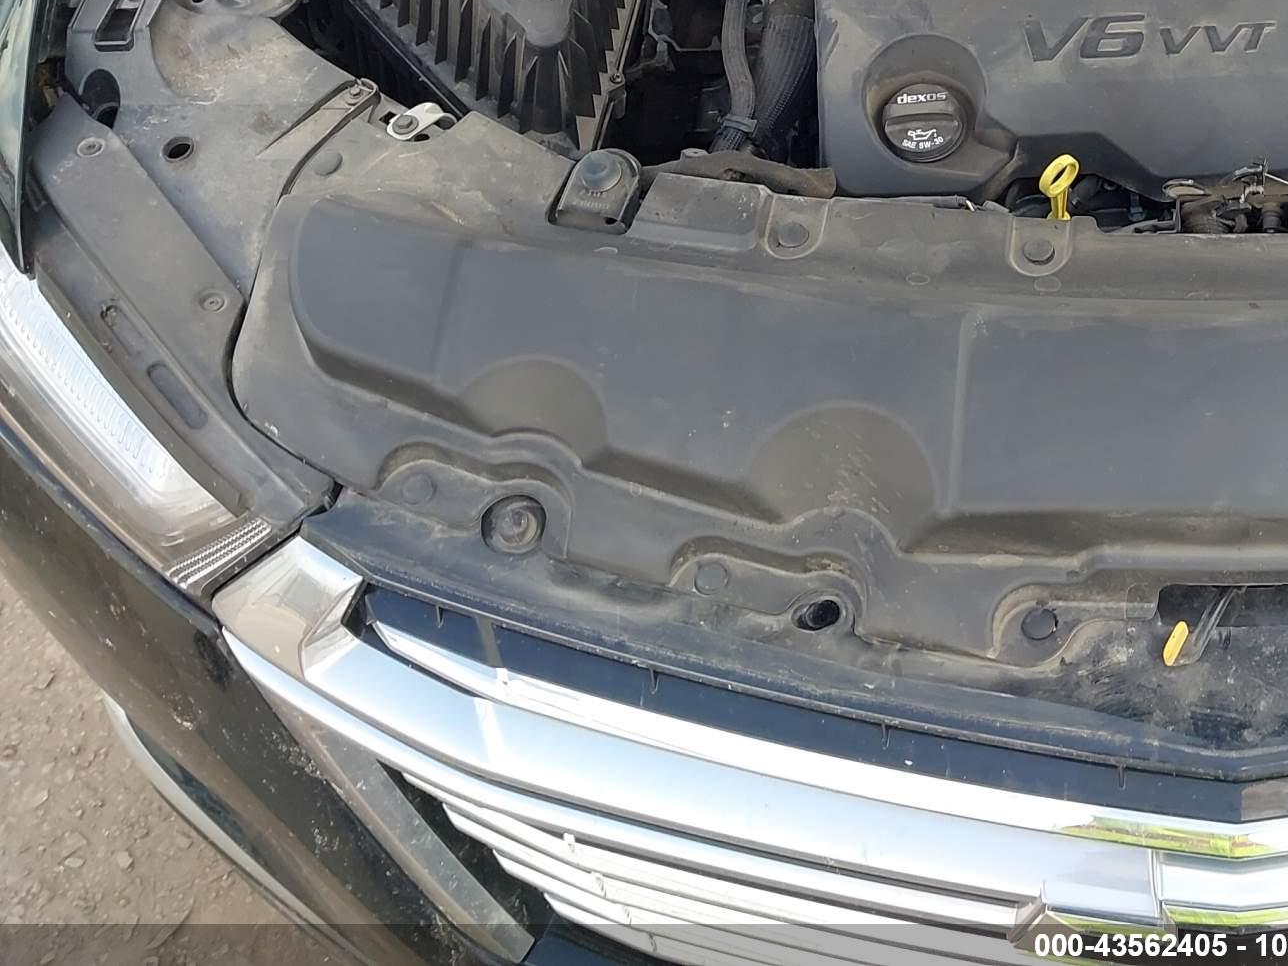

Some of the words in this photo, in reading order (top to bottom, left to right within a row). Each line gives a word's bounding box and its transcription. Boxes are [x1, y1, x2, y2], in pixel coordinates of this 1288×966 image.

[1023, 12, 1145, 63] V6
[1159, 20, 1277, 56] VVT
[896, 91, 949, 105] dexos
[902, 138, 917, 149] SAE
[918, 136, 944, 149] 5W-30
